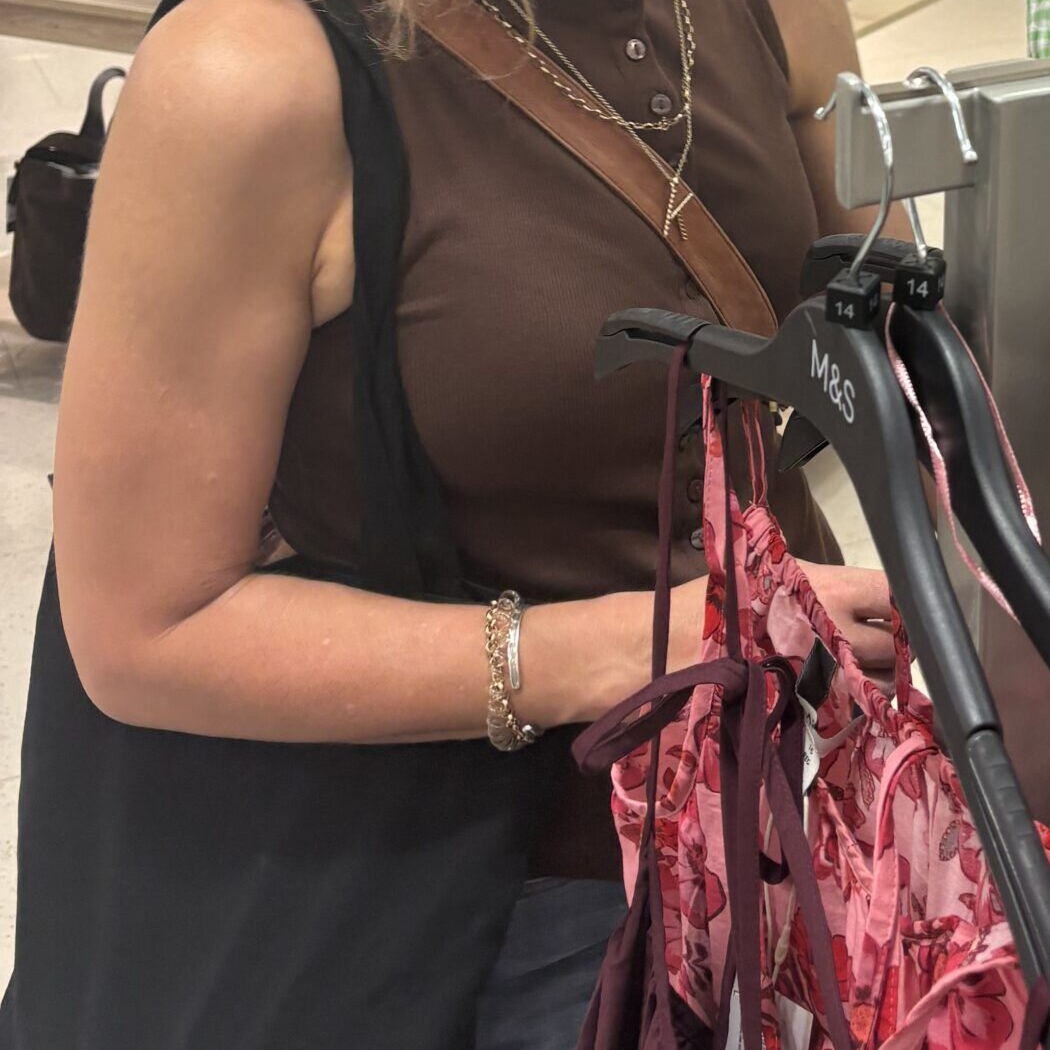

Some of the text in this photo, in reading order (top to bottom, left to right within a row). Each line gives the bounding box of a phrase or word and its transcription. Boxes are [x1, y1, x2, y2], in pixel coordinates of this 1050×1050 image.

[906, 278, 929, 298] 14
[834, 301, 855, 319] 14
[811, 338, 856, 423] M&S
